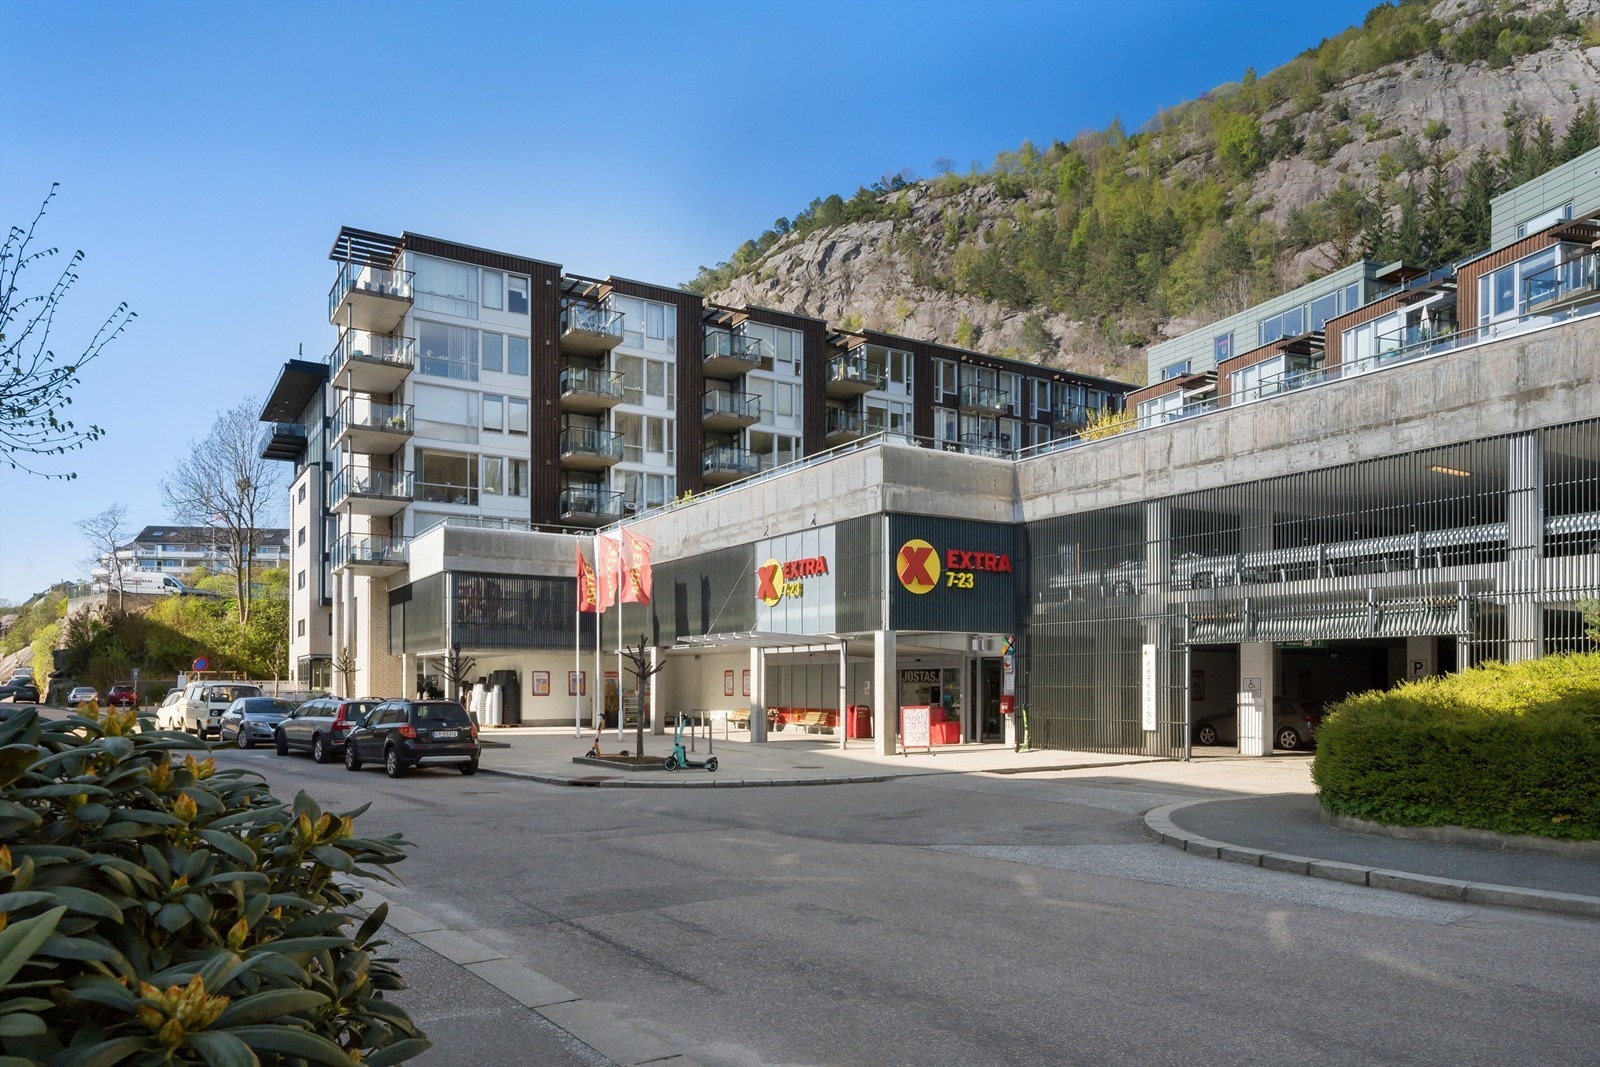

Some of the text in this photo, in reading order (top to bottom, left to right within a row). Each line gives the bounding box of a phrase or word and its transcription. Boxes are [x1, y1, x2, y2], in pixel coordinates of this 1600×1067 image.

[783, 556, 828, 579] EXTRA
[946, 549, 1012, 573] EXTRA
[946, 572, 974, 588] 7-23
[784, 582, 803, 598] 7-23
[1414, 661, 1423, 675] P
